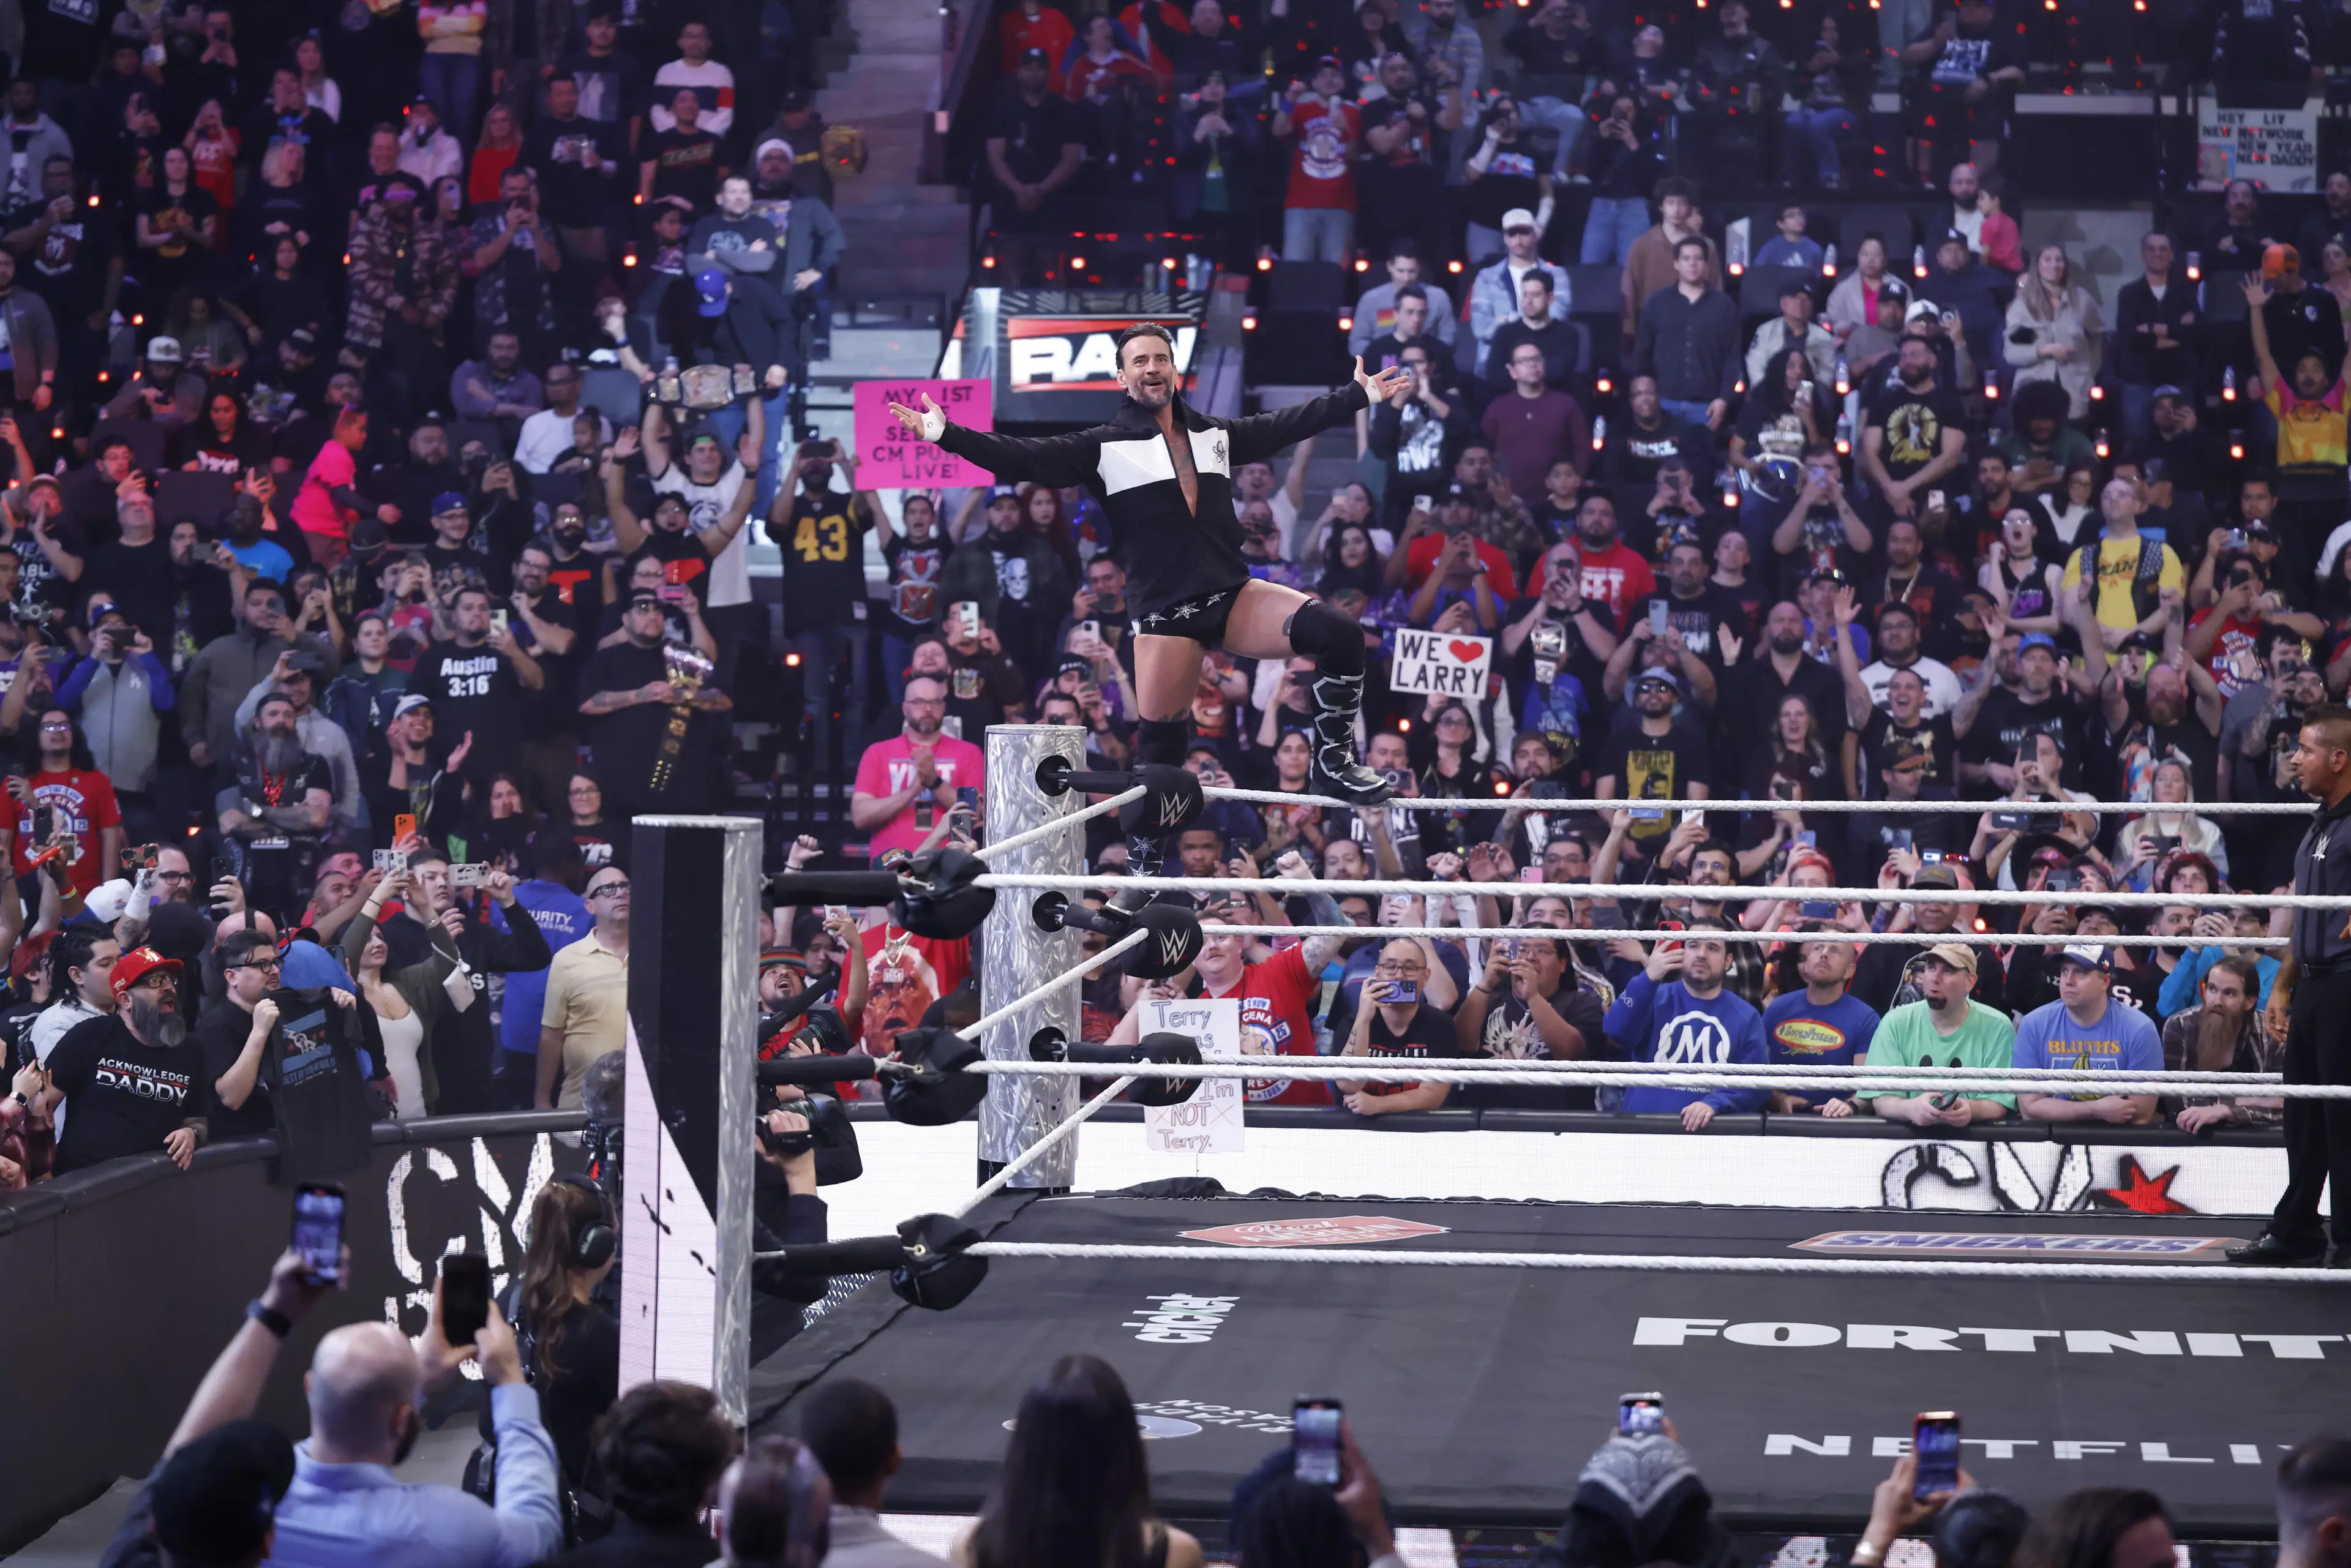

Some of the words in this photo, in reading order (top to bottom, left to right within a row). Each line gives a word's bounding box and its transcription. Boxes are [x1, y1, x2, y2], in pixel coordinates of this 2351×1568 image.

[2217, 111, 2246, 123] HEY
[2263, 111, 2286, 126] LIV
[2202, 126, 2232, 138] NEW
[2237, 126, 2304, 141] NETWORK
[2237, 140, 2267, 151] NEW
[2276, 141, 2314, 154] YEAR
[882, 387, 917, 405] MY
[872, 446, 904, 462] CM
[916, 445, 960, 462] PUN
[902, 462, 962, 480] LIVE!
[793, 514, 848, 563] 43
[1401, 633, 1442, 662] WE
[440, 656, 498, 677] Austin
[448, 674, 492, 697] 3:16
[1395, 661, 1484, 695] LARRY
[527, 909, 573, 926] URITY
[1150, 1001, 1211, 1029] Terry
[1242, 1011, 1272, 1024] CENA
[1275, 1024, 1288, 1040] 25
[97, 1057, 190, 1085] ACKNOWLEDGE
[96, 1069, 187, 1106] DADDY
[1199, 1078, 1234, 1101] I'm
[1263, 1084, 1282, 1099] TOUR
[1171, 1103, 1210, 1127] NOT
[1157, 1129, 1212, 1153] Terry.
[1234, 1220, 1338, 1237] Real
[1240, 1224, 1411, 1242] AMERICAN
[1838, 1232, 2201, 1253] SNICKERS
[1122, 1293, 1240, 1343] cricket
[1633, 1317, 2351, 1359] FORTNIT
[1764, 1434, 2295, 1465] NETFLI
